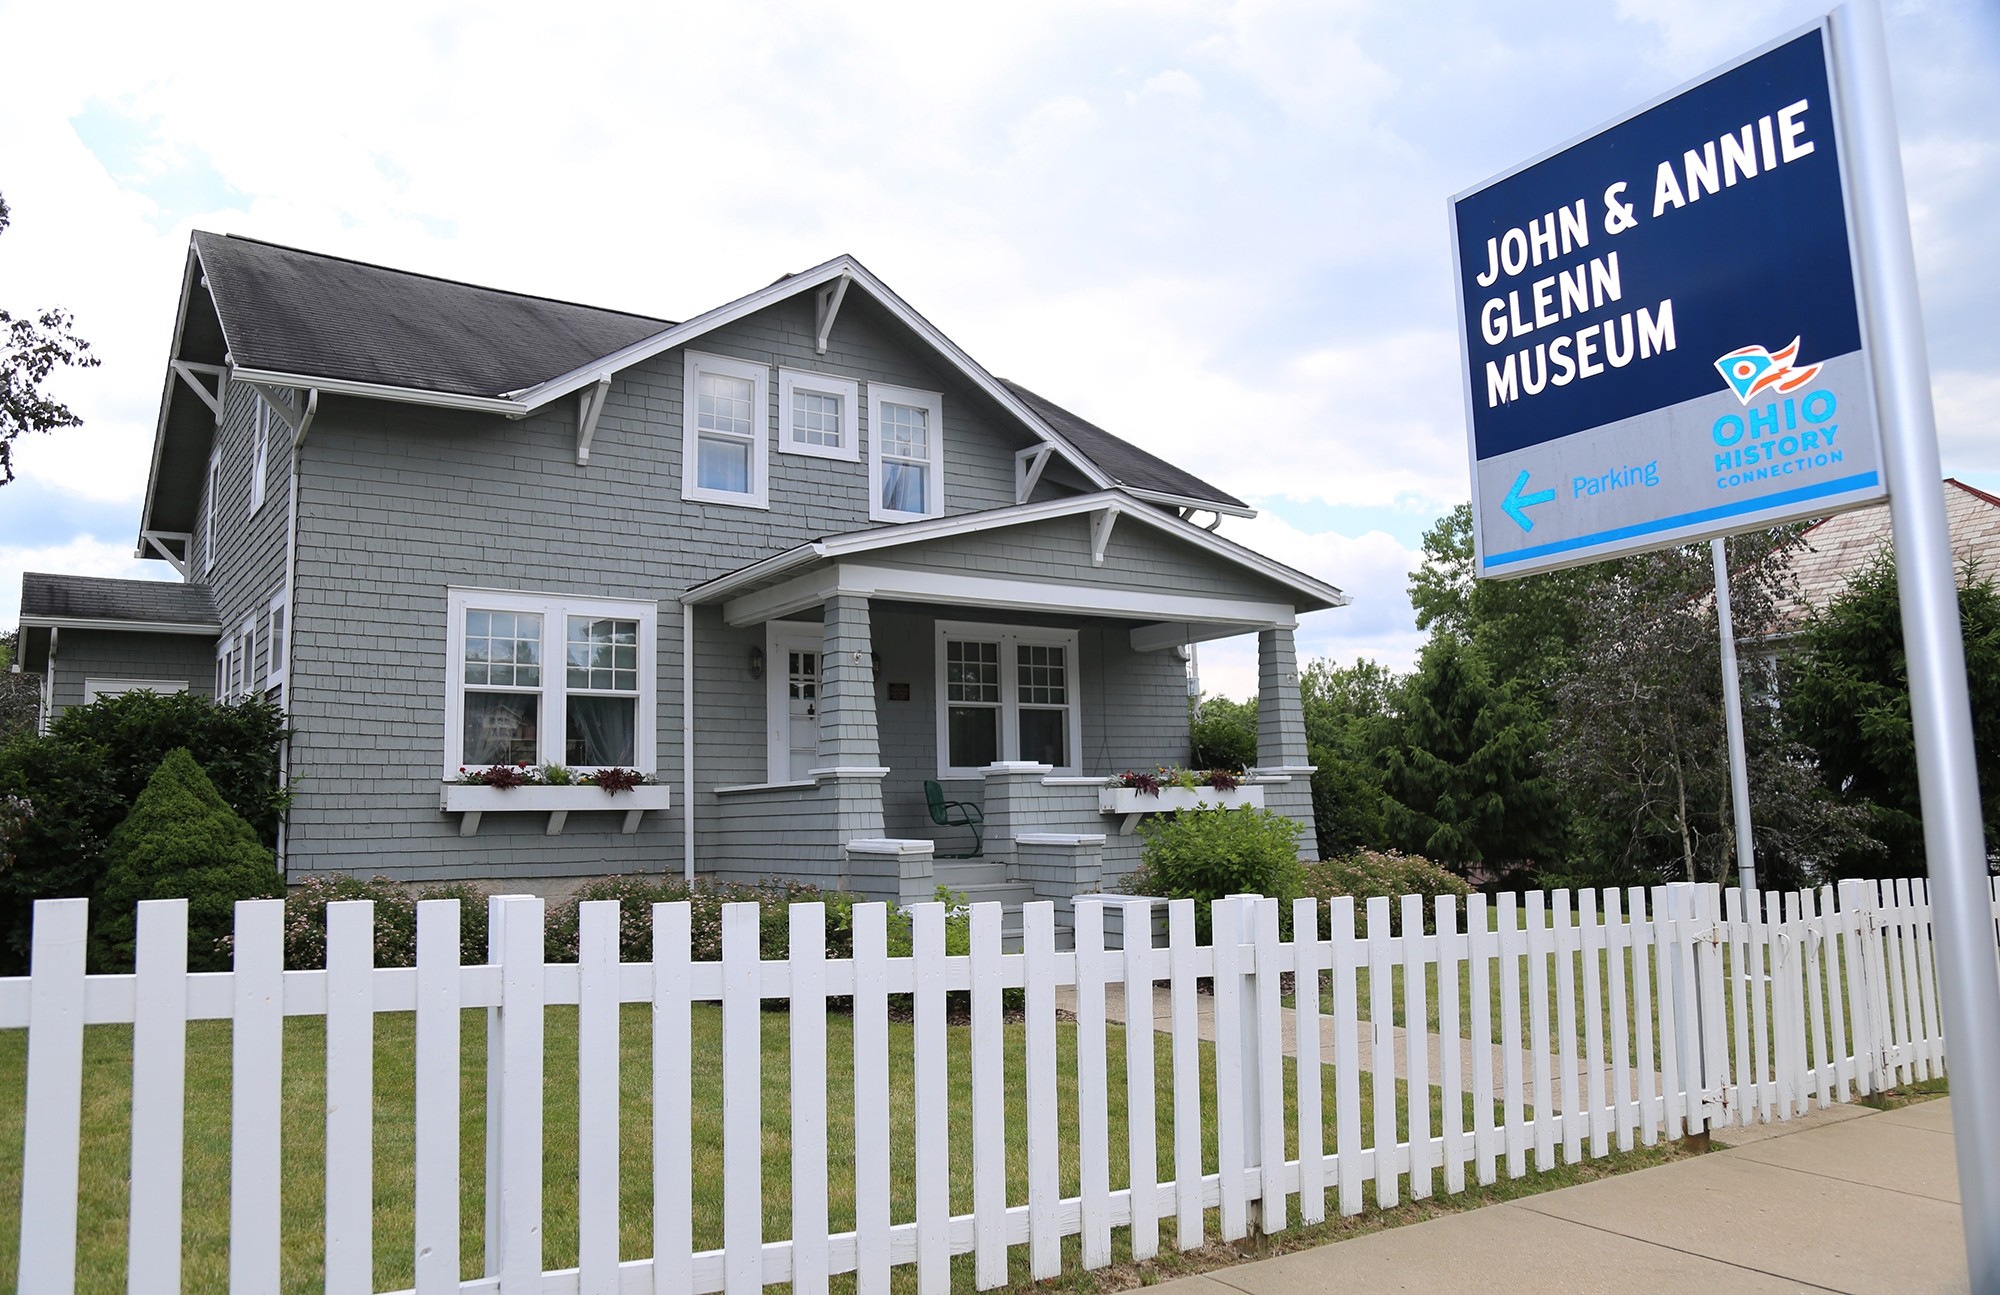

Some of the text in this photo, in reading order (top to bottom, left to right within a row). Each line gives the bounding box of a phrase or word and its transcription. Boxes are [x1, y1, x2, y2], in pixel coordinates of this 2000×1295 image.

[1476, 98, 1815, 287] JOHN & ANNIE
[1481, 250, 1622, 346] GLENN
[1485, 298, 1677, 408] MUSEUM
[1711, 388, 1838, 447] OHIO
[1714, 424, 1840, 473] HISTORY
[1715, 450, 1844, 490] CONNECTION
[1572, 460, 1661, 499] Parking
